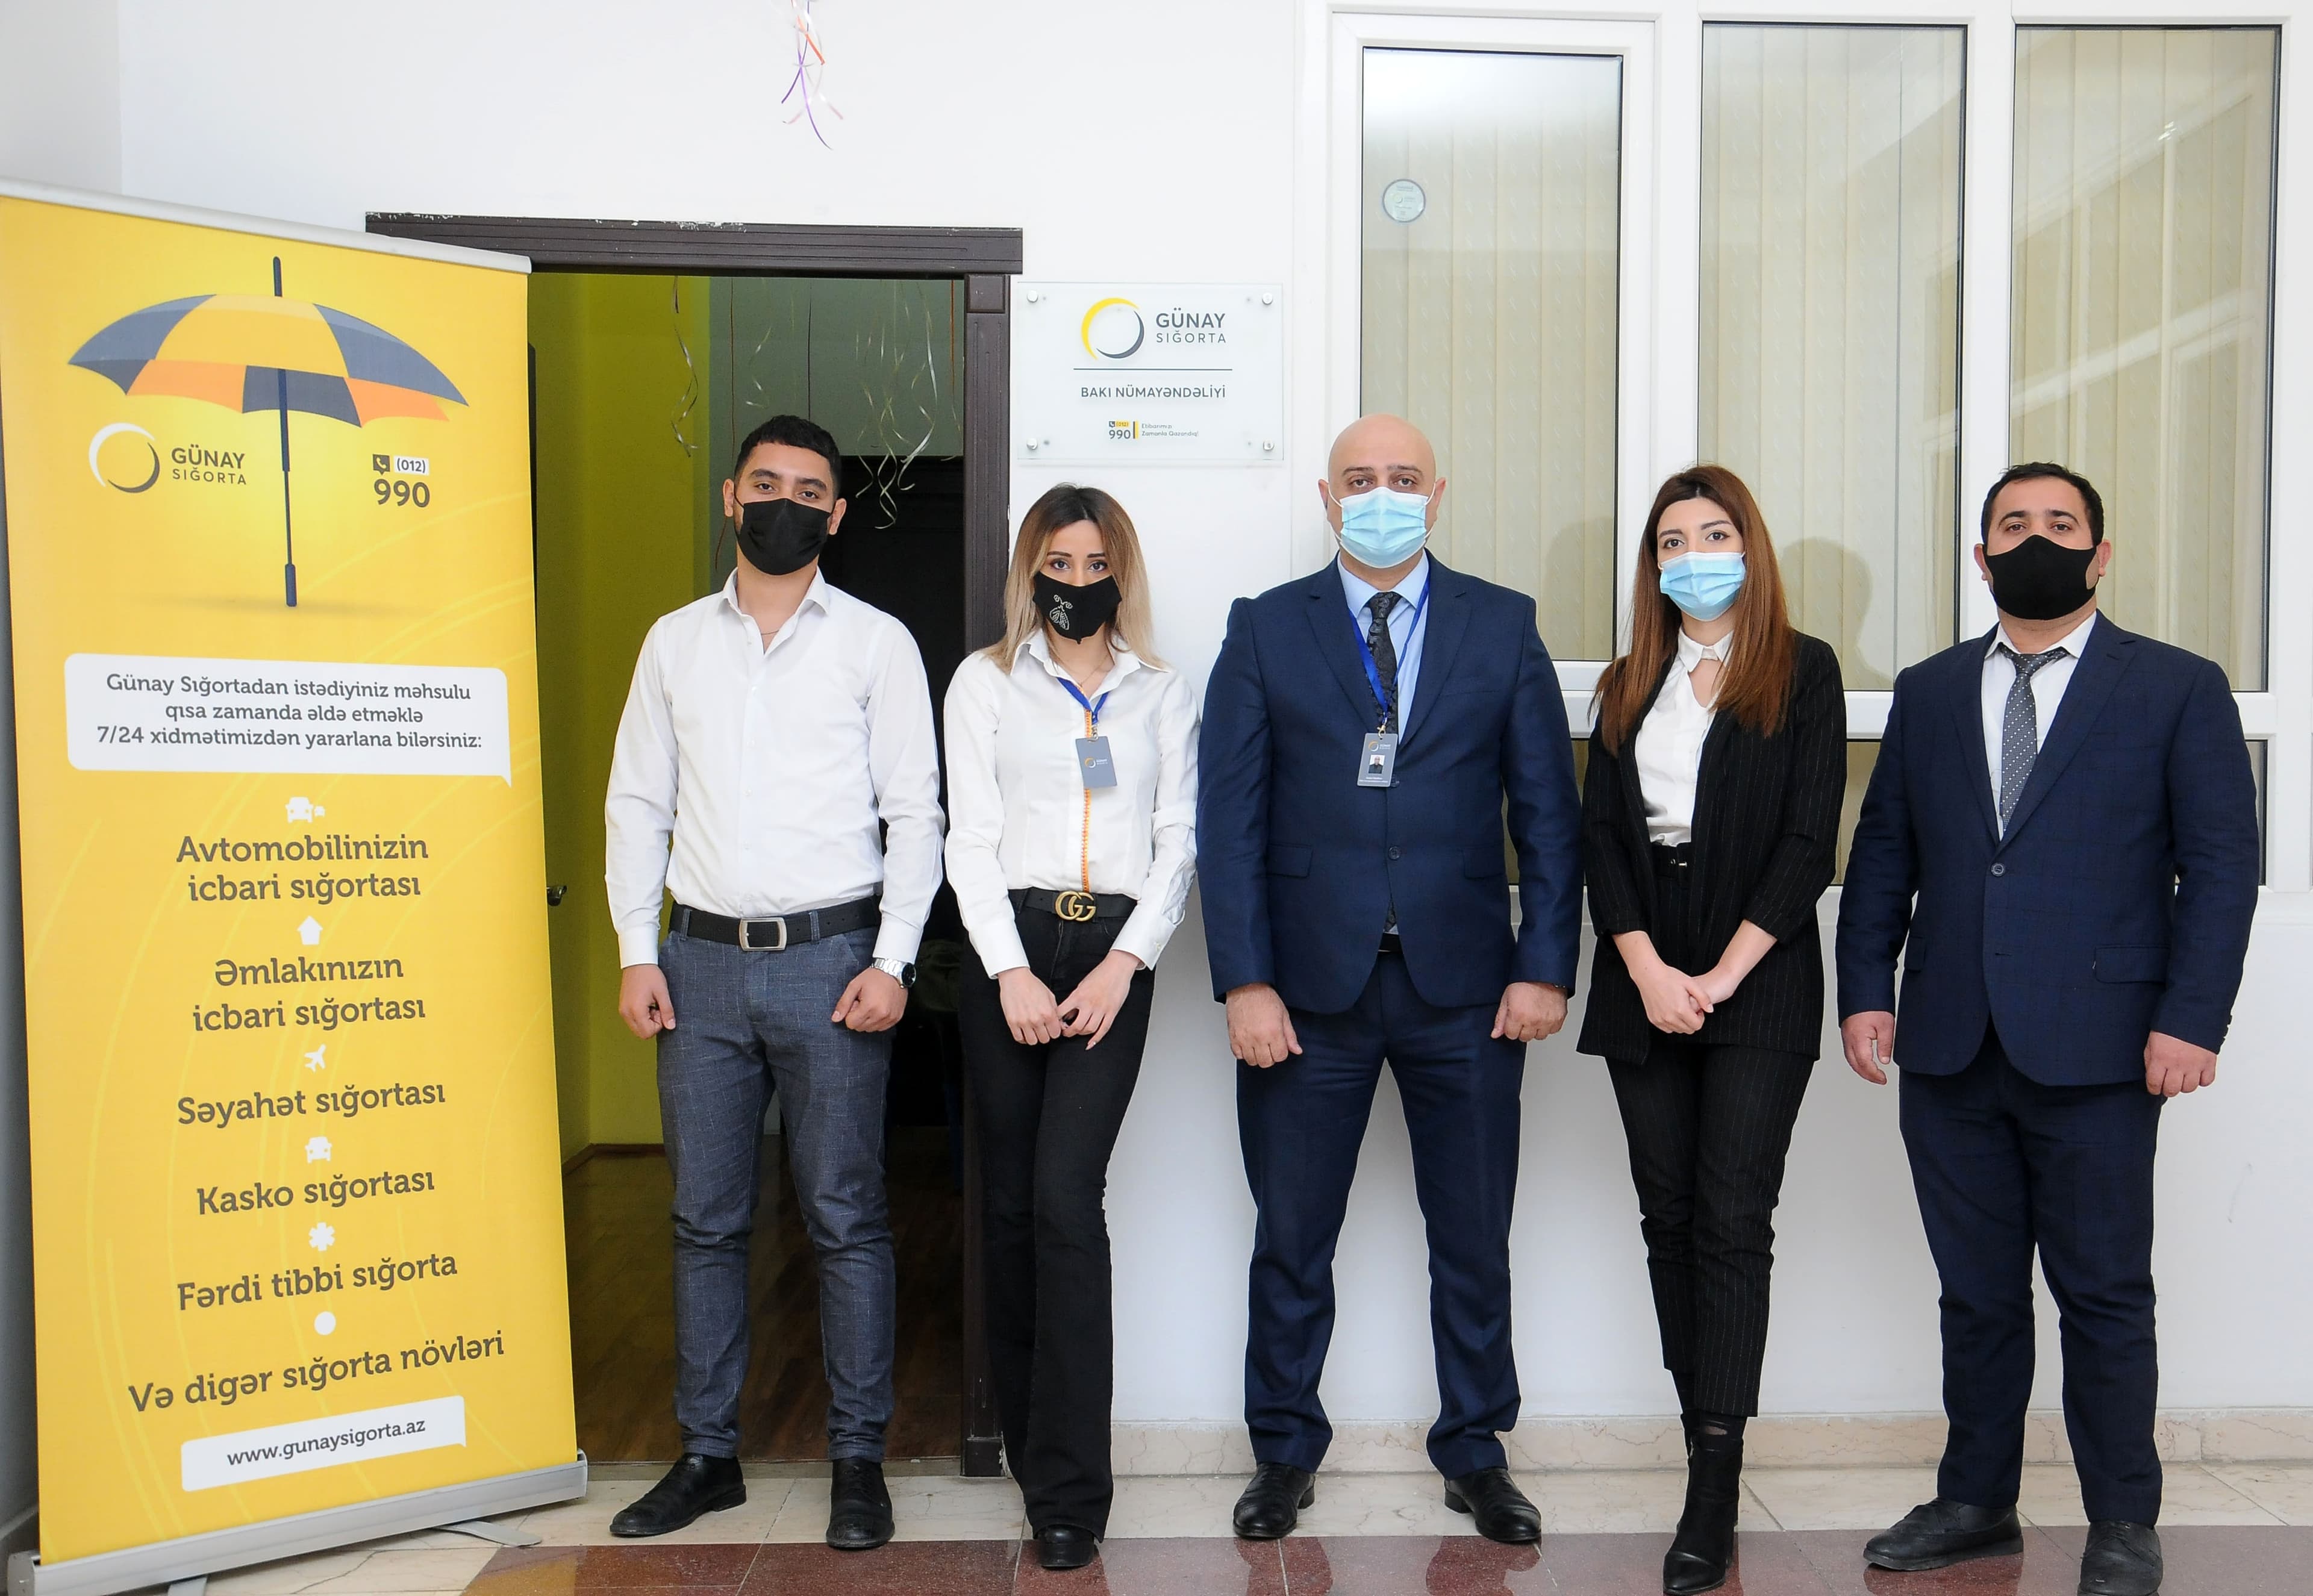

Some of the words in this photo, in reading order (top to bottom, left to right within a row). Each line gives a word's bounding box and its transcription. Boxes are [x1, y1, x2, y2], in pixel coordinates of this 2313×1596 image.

[1155, 307, 1226, 328] GÜNAY
[1156, 329, 1226, 343] SIĞORTA
[1081, 387, 1111, 398] BAKI
[1116, 384, 1225, 399] NÜMAYƏNDƏLİYİ
[1109, 429, 1131, 439] 990
[171, 443, 245, 470] GÜNAY
[396, 457, 426, 474] (012)
[172, 466, 246, 485] SIĞORTA
[373, 478, 431, 508] 990
[107, 673, 175, 696] Günay
[181, 676, 289, 697] Sığortadan
[293, 679, 389, 701] istədiyiniz
[393, 683, 471, 700] məhsulu
[165, 705, 207, 722] qısa
[213, 704, 303, 720] zamanda
[307, 705, 346, 722] əldə
[352, 706, 423, 723] etməklə
[97, 725, 145, 744] 7/24
[150, 727, 301, 746] xidmətimizdən
[305, 731, 393, 750] yararlana
[396, 731, 482, 748] bilərsiniz:
[176, 834, 429, 863] Avtomobilinizin
[187, 873, 281, 902] icbari
[290, 871, 421, 905] sığortası
[215, 956, 404, 987] Əmlakınızın
[192, 1000, 286, 1032] icbari
[295, 997, 426, 1031] sığortası
[178, 1090, 307, 1129] Səyahət
[316, 1082, 446, 1118] sığortası
[196, 1182, 294, 1215] Kasko
[304, 1171, 435, 1208] sığortası
[177, 1273, 263, 1311] Fərdi
[271, 1263, 344, 1298] tibbi
[352, 1253, 458, 1291] sığorta
[128, 1382, 174, 1412] Və
[185, 1371, 273, 1406] digər
[283, 1351, 392, 1391] sığorta
[400, 1329, 504, 1370] növləri
[226, 1420, 426, 1466] www.gunaysigorta.az
